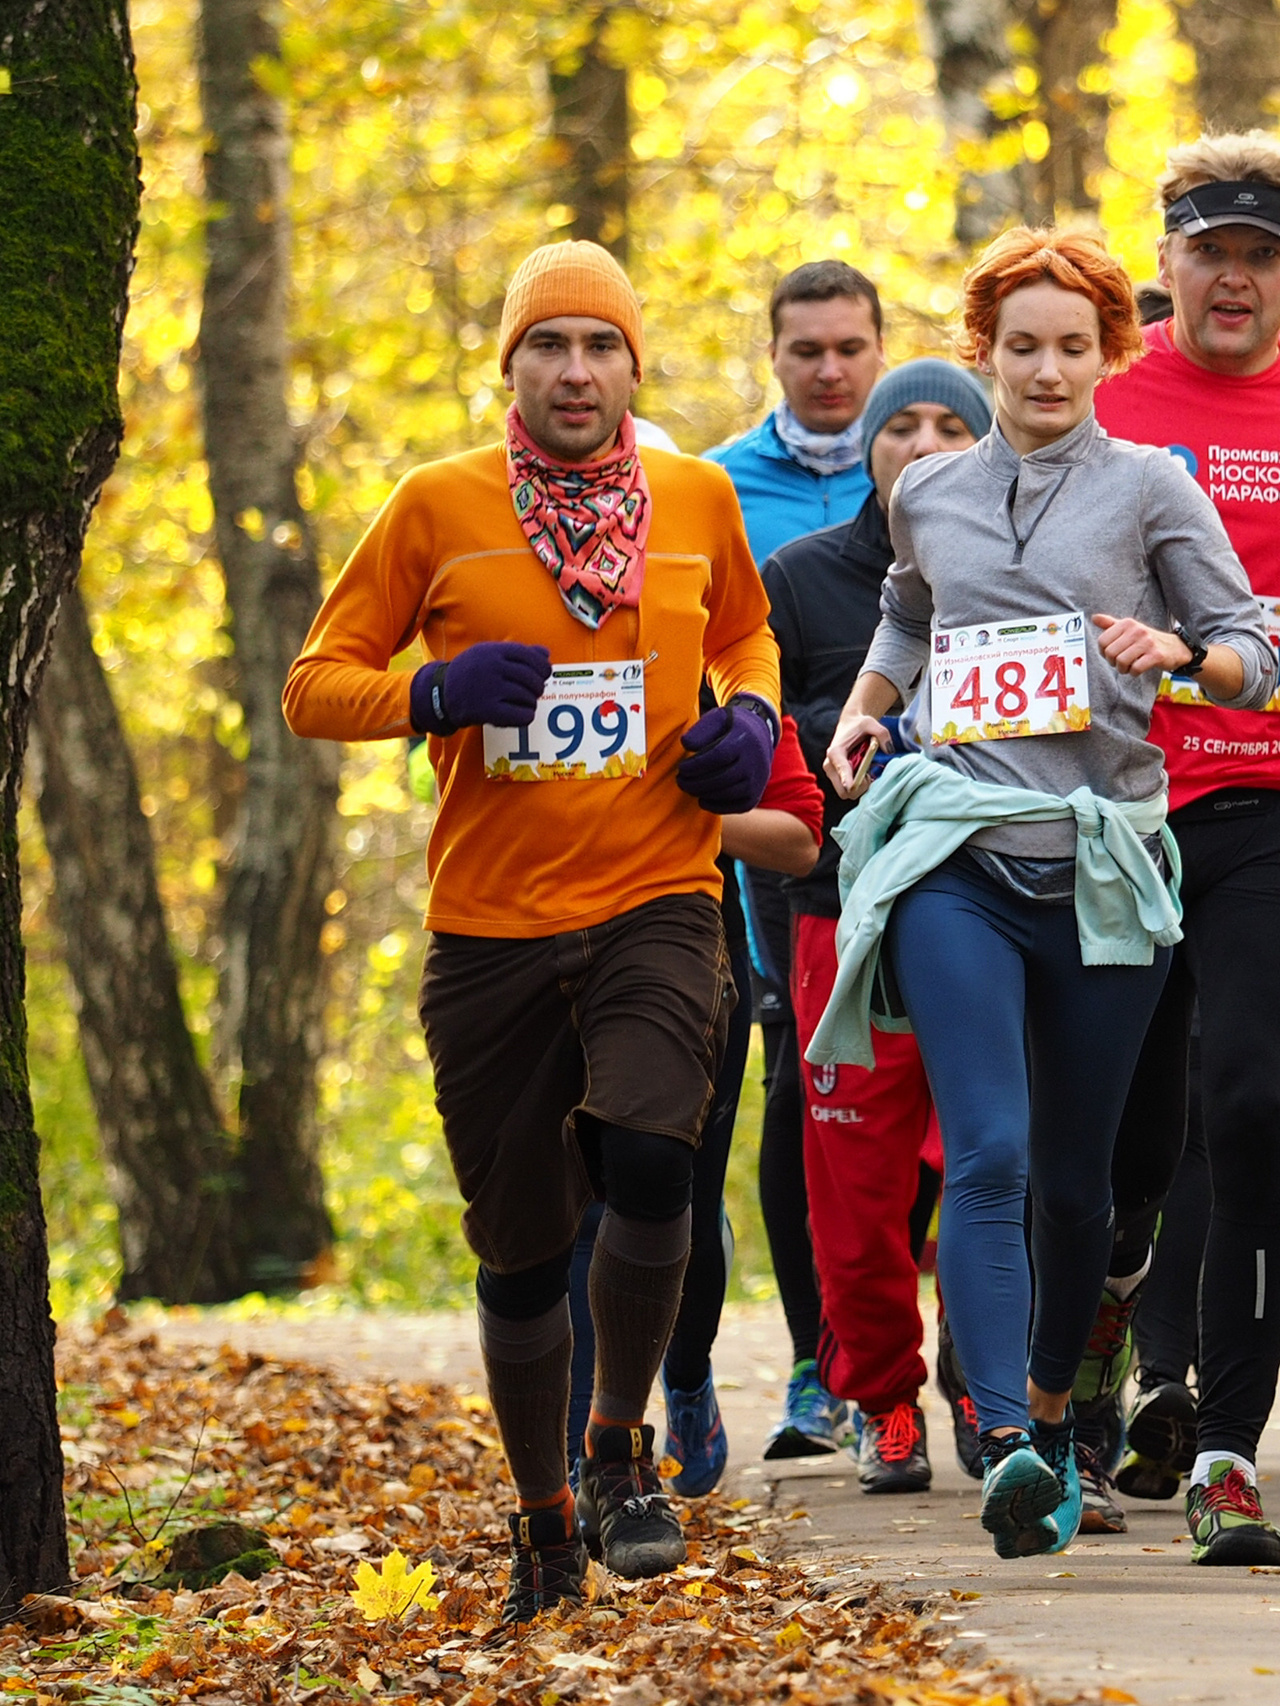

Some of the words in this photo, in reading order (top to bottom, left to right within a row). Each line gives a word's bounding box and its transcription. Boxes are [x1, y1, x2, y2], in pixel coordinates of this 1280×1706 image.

[944, 651, 1001, 666] Измайловский
[1002, 645, 1060, 658] полумарафон
[558, 690, 617, 701] полумарафон
[950, 655, 1075, 721] 484
[509, 703, 629, 761] 199
[1182, 735, 1200, 751] 25
[1203, 738, 1270, 756] СЕНТЯБРЯ
[811, 1104, 864, 1123] OPEL
